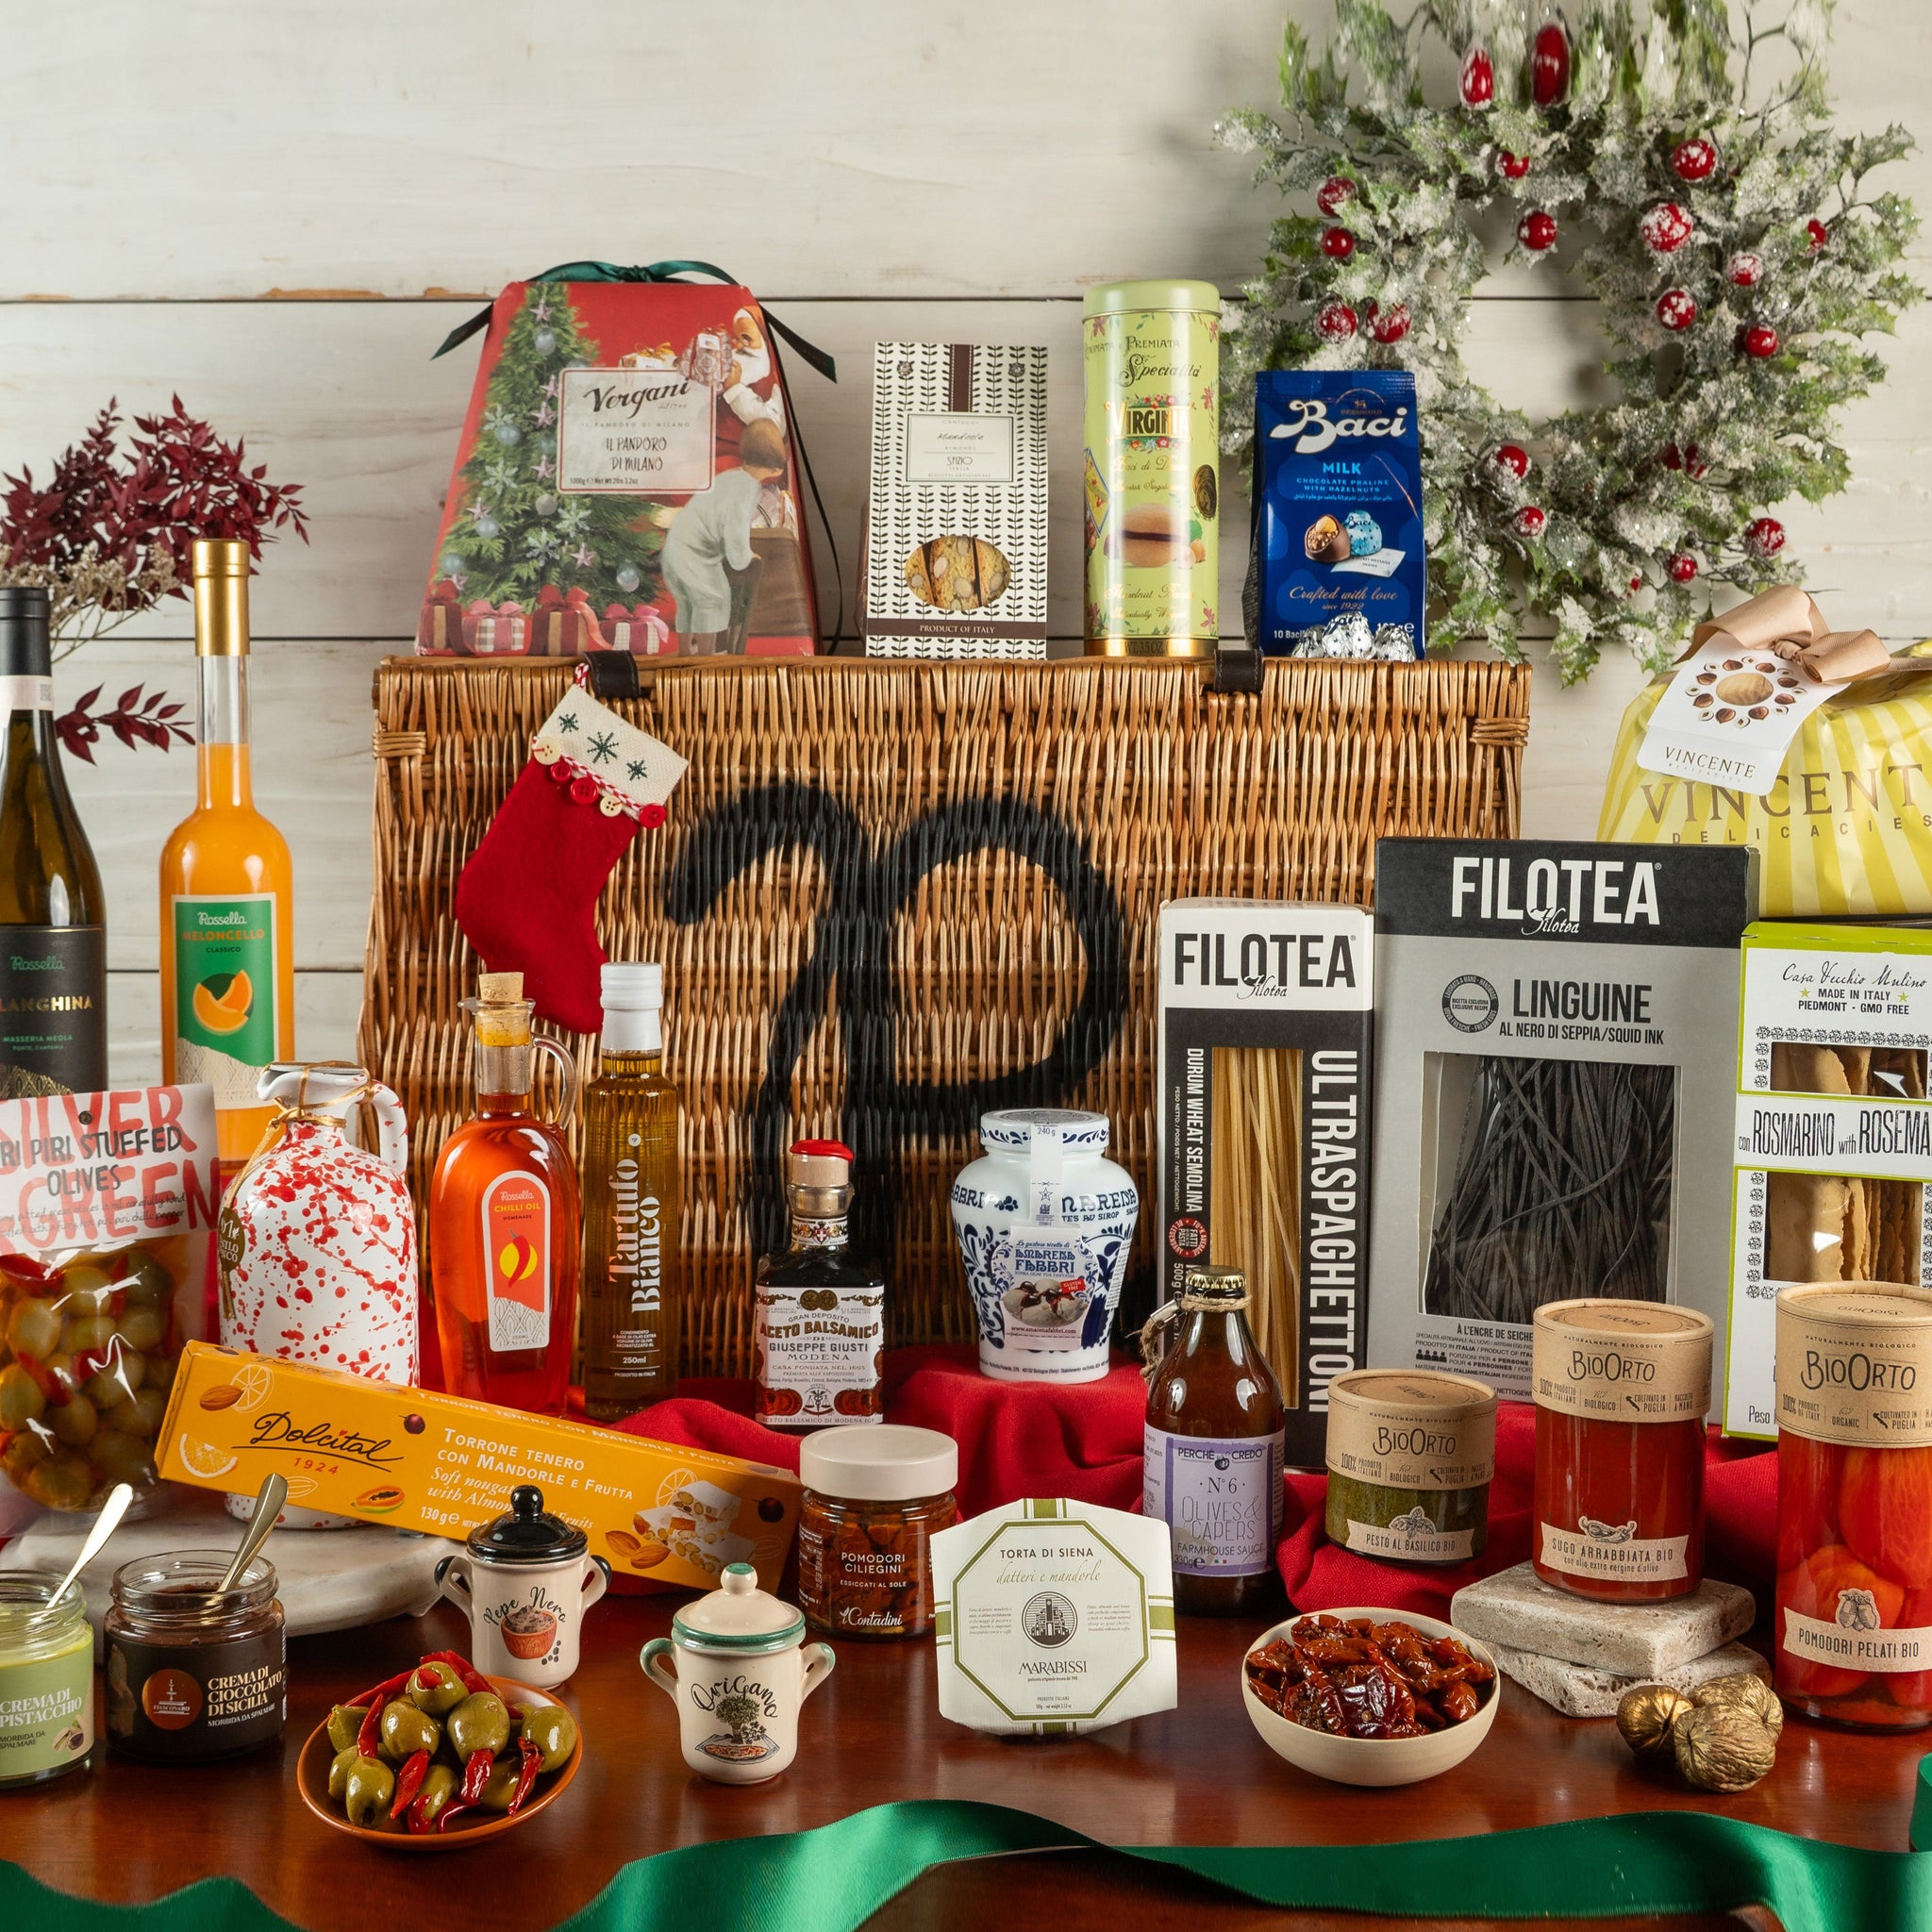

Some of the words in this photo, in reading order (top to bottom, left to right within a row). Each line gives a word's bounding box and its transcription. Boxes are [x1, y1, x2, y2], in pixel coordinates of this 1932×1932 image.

[583, 377, 691, 419] Vergani
[1269, 399, 1407, 454] Baci
[606, 438, 613, 450] IL
[617, 437, 667, 451] PANDORO
[611, 458, 622, 471] DI
[625, 457, 663, 471] MILANO
[1323, 462, 1361, 475] MILK
[1290, 586, 1338, 604] Crafted
[1341, 587, 1367, 600] with
[1371, 586, 1397, 600] love
[1340, 602, 1365, 610] 1922
[919, 625, 958, 633] PRODUCT
[959, 625, 971, 633] OF
[973, 625, 995, 634] ITALY
[1274, 630, 1284, 639] 10
[1665, 746, 1756, 778] VINCENTE
[1673, 814, 1932, 843] DELICACIES
[1451, 857, 1660, 925] FILOTEA
[197, 911, 247, 926] Rossella
[1521, 907, 1580, 935] Filotea
[183, 929, 265, 941] MELONCELLO
[10, 955, 65, 971] Rossella
[1174, 932, 1357, 988] FILOTEA
[1783, 963, 1816, 983] Casa
[1821, 960, 1866, 985] Vecchio
[1872, 965, 1927, 988] Mulino
[1513, 979, 1652, 1023] LINGUINE
[1818, 989, 1845, 999] MADE
[1850, 990, 1859, 1000] IN
[1864, 991, 1890, 1001] ITALY
[1798, 1000, 1847, 1012] PIEDMONT
[1860, 1004, 1883, 1014] GMO
[1887, 1004, 1909, 1015] FREE
[1499, 1022, 1513, 1037] AL
[1516, 1024, 1544, 1039] NERO
[1548, 1025, 1558, 1040] DI
[1561, 1025, 1641, 1044] SEPPIA/SQUID
[1644, 1029, 1664, 1045] INK
[1186, 1048, 1204, 1094] DURUM
[1186, 1098, 1204, 1144] WHEAT
[1739, 1134, 1750, 1151] con
[1753, 1109, 1835, 1157] ROSMARINO
[1839, 1134, 1857, 1155] with
[31, 1136, 72, 1165] PIRI
[81, 1126, 182, 1159] STUFFED
[47, 1164, 122, 1197] OLIVES
[1186, 1146, 1204, 1213] SEMOLINA
[19, 1158, 221, 1248] GREEN
[494, 1205, 524, 1213] CHILLI
[608, 1158, 640, 1283] Tartufo
[1098, 1211, 1120, 1221] SIROP
[631, 1196, 660, 1313] Bianco
[1015, 1249, 1075, 1260] AMARENA
[1015, 1259, 1074, 1274] FABBRI
[788, 1313, 810, 1323] GRAN
[811, 1312, 850, 1324] DEPOSITO
[759, 1322, 801, 1340] ACETO
[804, 1321, 878, 1340] BALSAMICO
[1464, 1325, 1493, 1338] L'ENCRE
[1495, 1329, 1506, 1339] DE
[1507, 1330, 1533, 1341] SEICHE
[769, 1342, 825, 1352] GIUSEPPE
[830, 1342, 869, 1352] GIUSTI
[1415, 1340, 1447, 1349] PRODOTTO
[1480, 1347, 1509, 1356] PRODUCT
[1806, 1335, 1865, 1347] NATURALMENTE
[623, 1356, 646, 1364] 250ml
[1474, 1361, 1512, 1371] PERSONNES
[1498, 1357, 1529, 1366] PERSONE
[1584, 1398, 1616, 1411] BIOLOGICO
[1643, 1403, 1666, 1413] PUGLIA
[1798, 1399, 1820, 1412] PRODUCT
[1749, 1405, 1770, 1424] Peso
[1806, 1409, 1820, 1421] ITALY
[1832, 1416, 1859, 1428] ORGANIC
[1880, 1410, 1910, 1419] CULTIVATED
[1892, 1420, 1916, 1429] PUGLIA
[250, 1411, 405, 1462] Dolcital
[443, 1427, 517, 1457] TORRONE
[526, 1449, 585, 1472] TENERO
[591, 1429, 674, 1454] MANDORLE
[690, 1452, 735, 1467] FRUTTA
[1178, 1447, 1214, 1460] PERCHÉ
[1231, 1448, 1262, 1460] CREDO
[293, 1457, 340, 1475] 1924
[437, 1449, 469, 1465] CON
[476, 1456, 564, 1486] MANDORLE
[585, 1479, 633, 1501] FRUTTA
[431, 1467, 461, 1486] Soft
[464, 1477, 516, 1496] nougat
[1228, 1477, 1238, 1493] 6
[1390, 1474, 1420, 1484] BIOLOGICO
[427, 1486, 462, 1502] with
[1182, 1496, 1241, 1523] OLIVES
[1191, 1521, 1256, 1541] CAPERS
[1177, 1542, 1235, 1556] FARMHOUSE
[1237, 1542, 1264, 1555] SAUCE
[1367, 1533, 1390, 1548] PESTO
[1392, 1538, 1402, 1550] AL
[1405, 1539, 1441, 1553] BASILICO
[1443, 1540, 1456, 1552] BIO
[1552, 1538, 1575, 1555] SUGO
[1581, 1546, 1651, 1562] ARRABBIATA
[1657, 1549, 1673, 1561] BIO
[841, 1552, 906, 1563] POMODORI
[1000, 1548, 1037, 1558] TORTA
[1041, 1548, 1054, 1557] DI
[1058, 1547, 1093, 1557] SIENA
[845, 1563, 901, 1574] CILIEGINI
[996, 1561, 1036, 1585] datteri
[1040, 1574, 1045, 1582] e
[1050, 1559, 1101, 1582] mandorle
[1576, 1558, 1588, 1568] olio
[1609, 1564, 1635, 1574] vergine
[840, 1579, 875, 1588] ESSICCATI
[483, 1598, 520, 1626] Pepe
[530, 1586, 566, 1624] Nero
[848, 1607, 903, 1626] Contadini
[1799, 1628, 1852, 1655] POMODORI
[1858, 1641, 1896, 1658] PELATI
[1902, 1642, 1919, 1658] BIO
[1019, 1660, 1087, 1675] MARABISSI
[208, 1673, 257, 1690] CREMA
[257, 1665, 269, 1680] DI
[208, 1670, 282, 1704] CIOCCOLATO
[0, 1693, 55, 1714] CREMA
[57, 1688, 70, 1704] DI
[208, 1704, 225, 1717] DI
[225, 1693, 269, 1714] SICILIA
[0, 1696, 82, 1728] PISTACCHIO
[208, 1716, 240, 1727] MORBIDA
[241, 1713, 250, 1722] DA
[250, 1704, 275, 1720] SPALMARE
